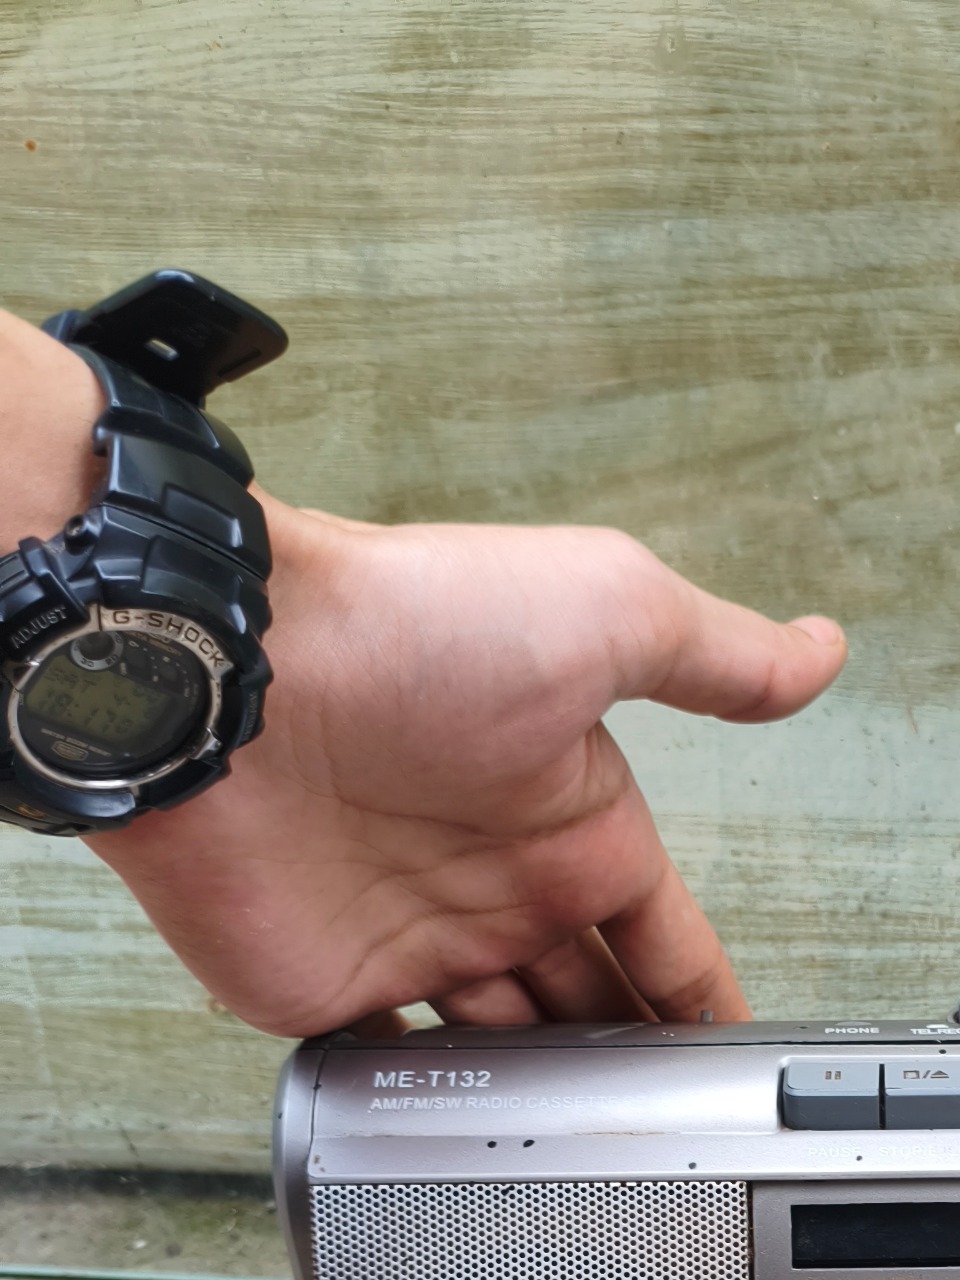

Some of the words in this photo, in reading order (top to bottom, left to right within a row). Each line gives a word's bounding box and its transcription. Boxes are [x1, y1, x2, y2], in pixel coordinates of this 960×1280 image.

[10, 605, 69, 649] ADJUST
[112, 609, 226, 668] G-SHOCK
[824, 1027, 880, 1035] PHONE
[373, 1070, 491, 1088] ME-T132
[370, 1097, 464, 1111] AM/FM/SW
[466, 1096, 522, 1110] RADIO
[526, 1096, 619, 1110] CASSETTE
[808, 1146, 861, 1158] PAUSE
